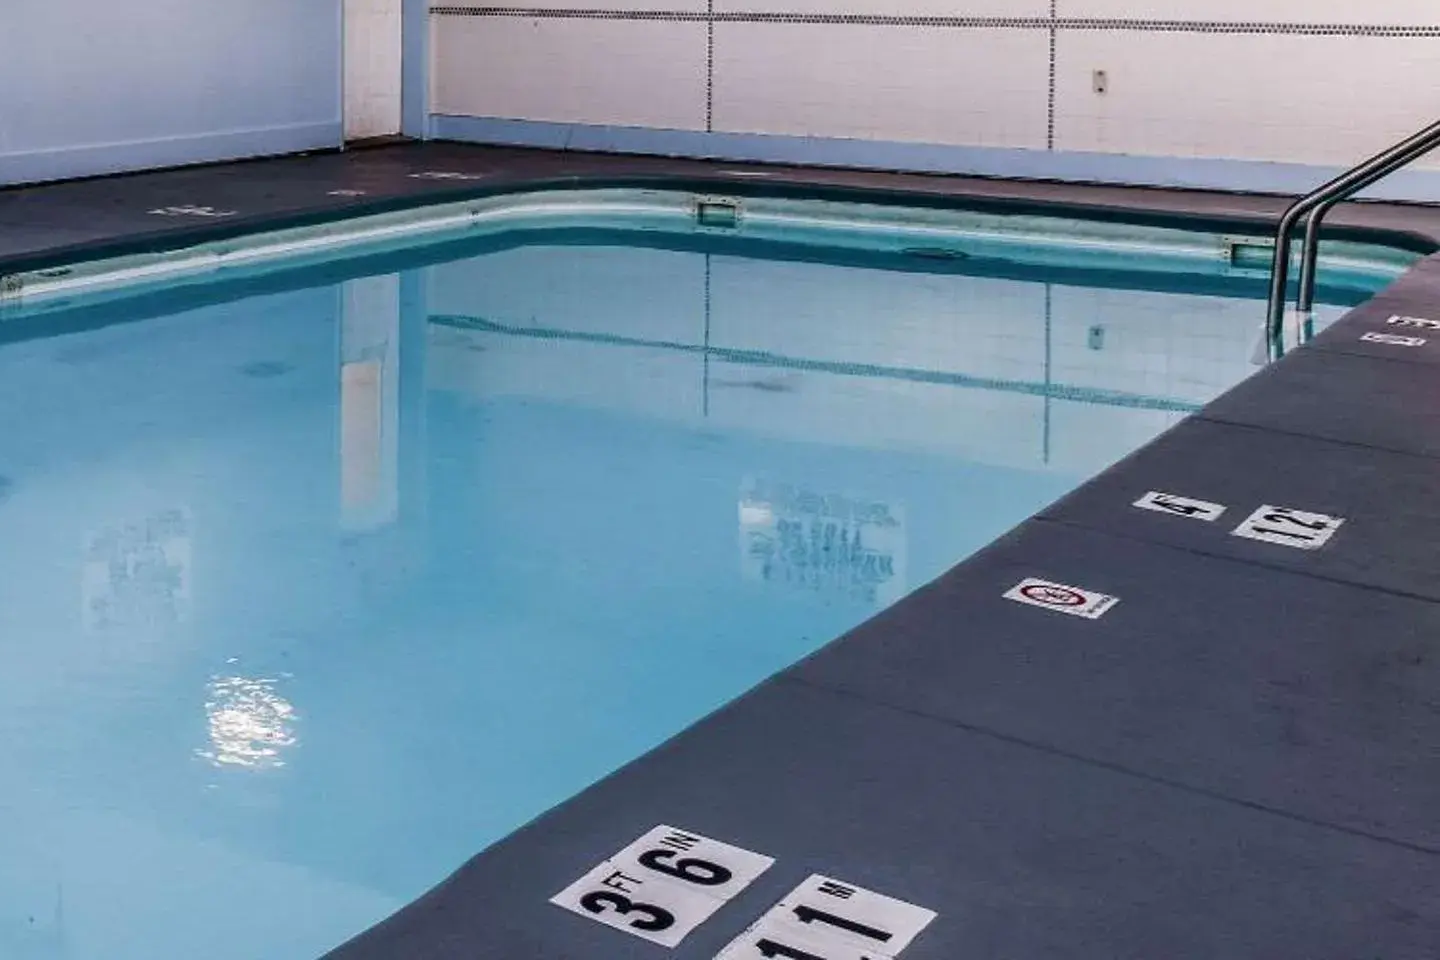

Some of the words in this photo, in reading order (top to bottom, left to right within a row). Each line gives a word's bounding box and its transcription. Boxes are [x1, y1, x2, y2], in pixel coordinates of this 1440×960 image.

[659, 830, 701, 852] IN
[601, 870, 644, 894] FT
[637, 848, 733, 886] 6
[579, 890, 676, 933] 3
